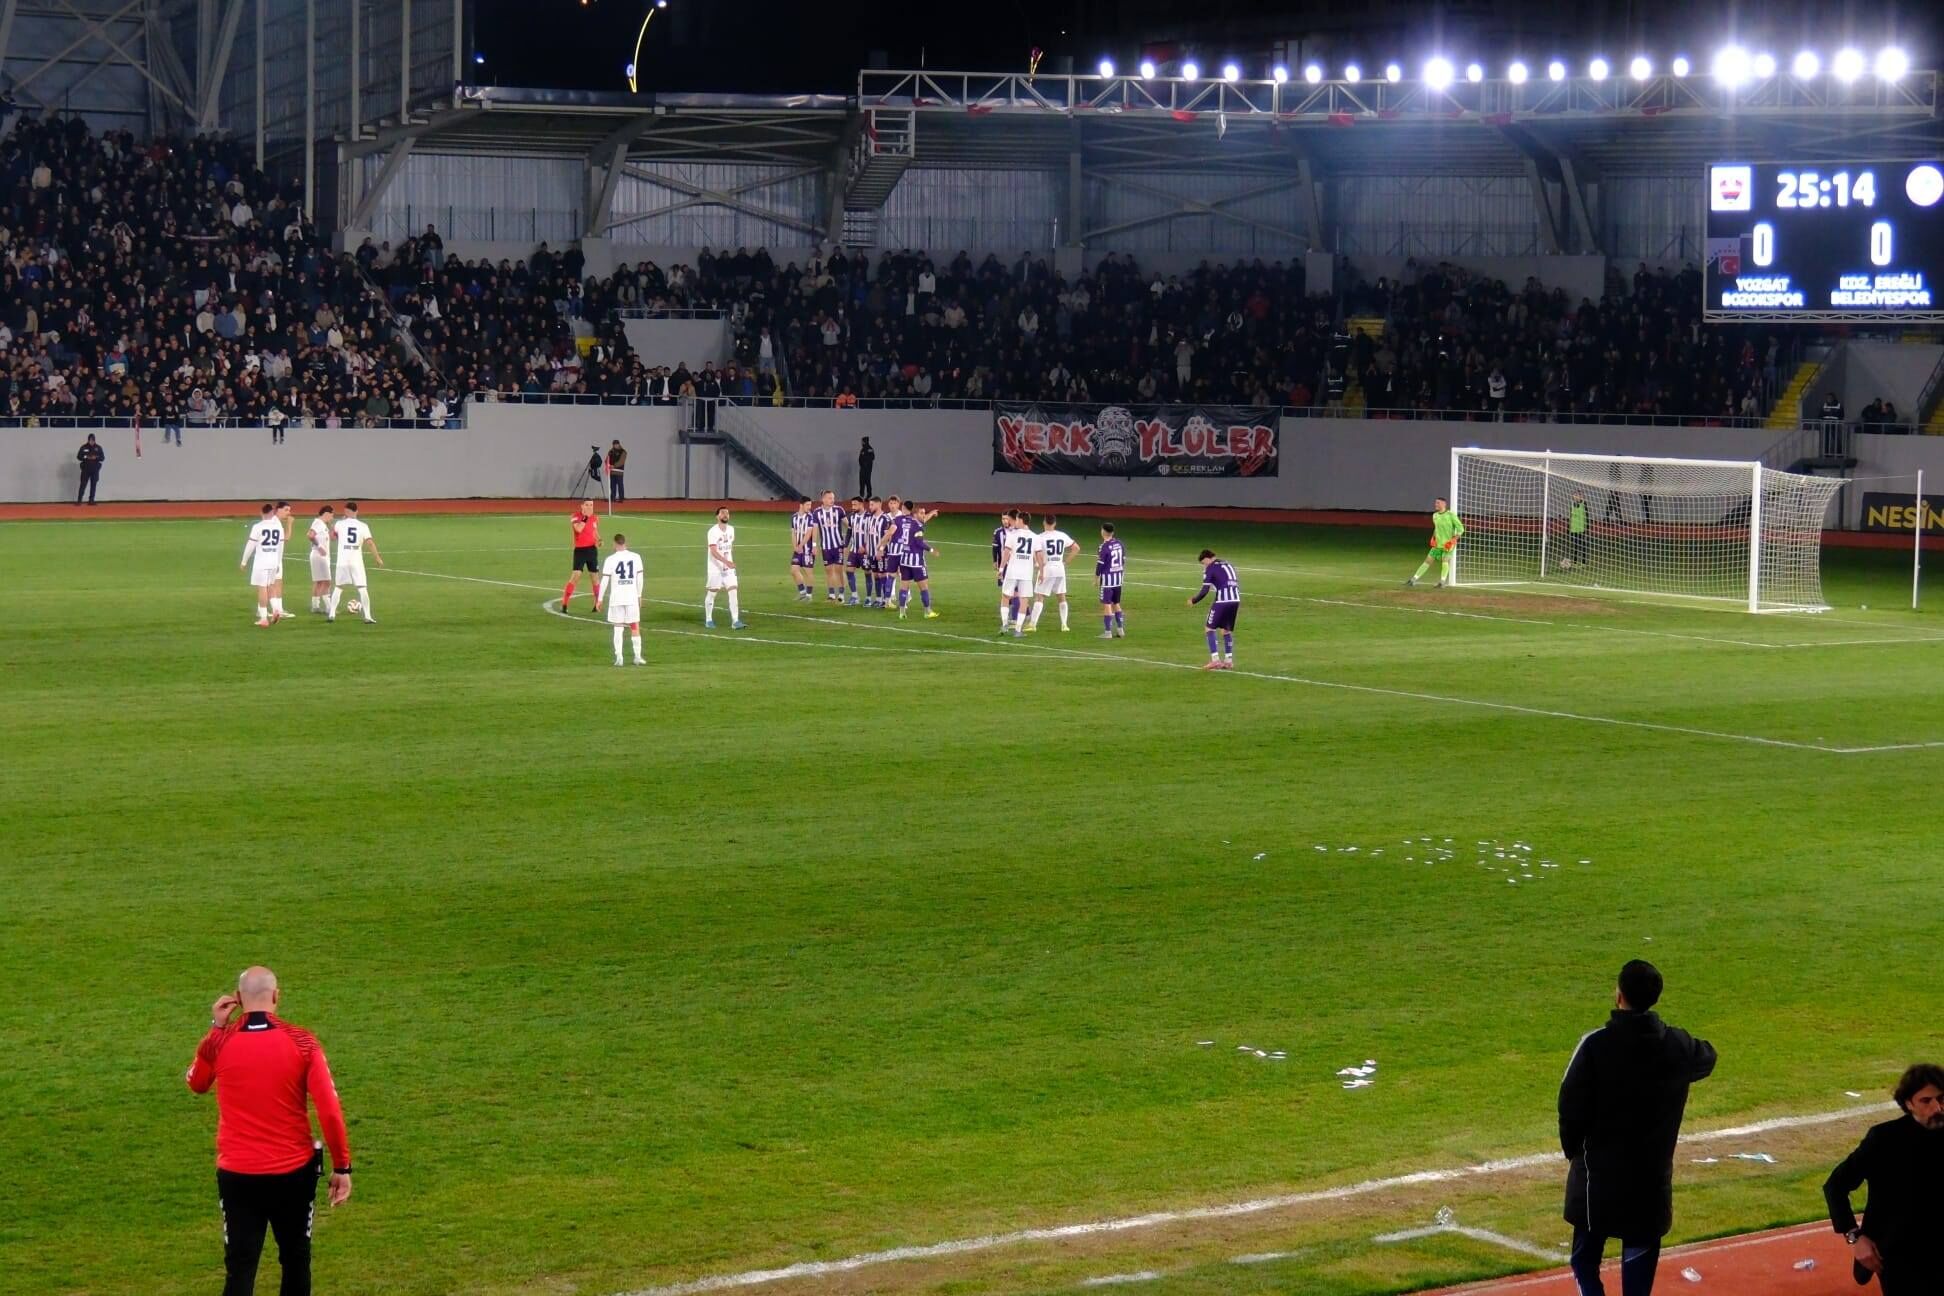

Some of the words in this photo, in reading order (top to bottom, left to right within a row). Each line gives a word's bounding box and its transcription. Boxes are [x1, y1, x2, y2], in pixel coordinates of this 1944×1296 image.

[1776, 172, 1876, 208] 25:14
[1753, 222, 1773, 266] 0
[1871, 222, 1892, 266] 0
[1736, 277, 1789, 291] YOZGAT
[1721, 292, 1803, 306] BOZOKSPOR
[261, 529, 280, 546] 29
[347, 527, 357, 544] 5
[1016, 536, 1033, 555] 21
[1046, 539, 1064, 556] 50
[1110, 549, 1122, 567] 21
[615, 560, 634, 579] 41
[1221, 564, 1237, 580] 11
